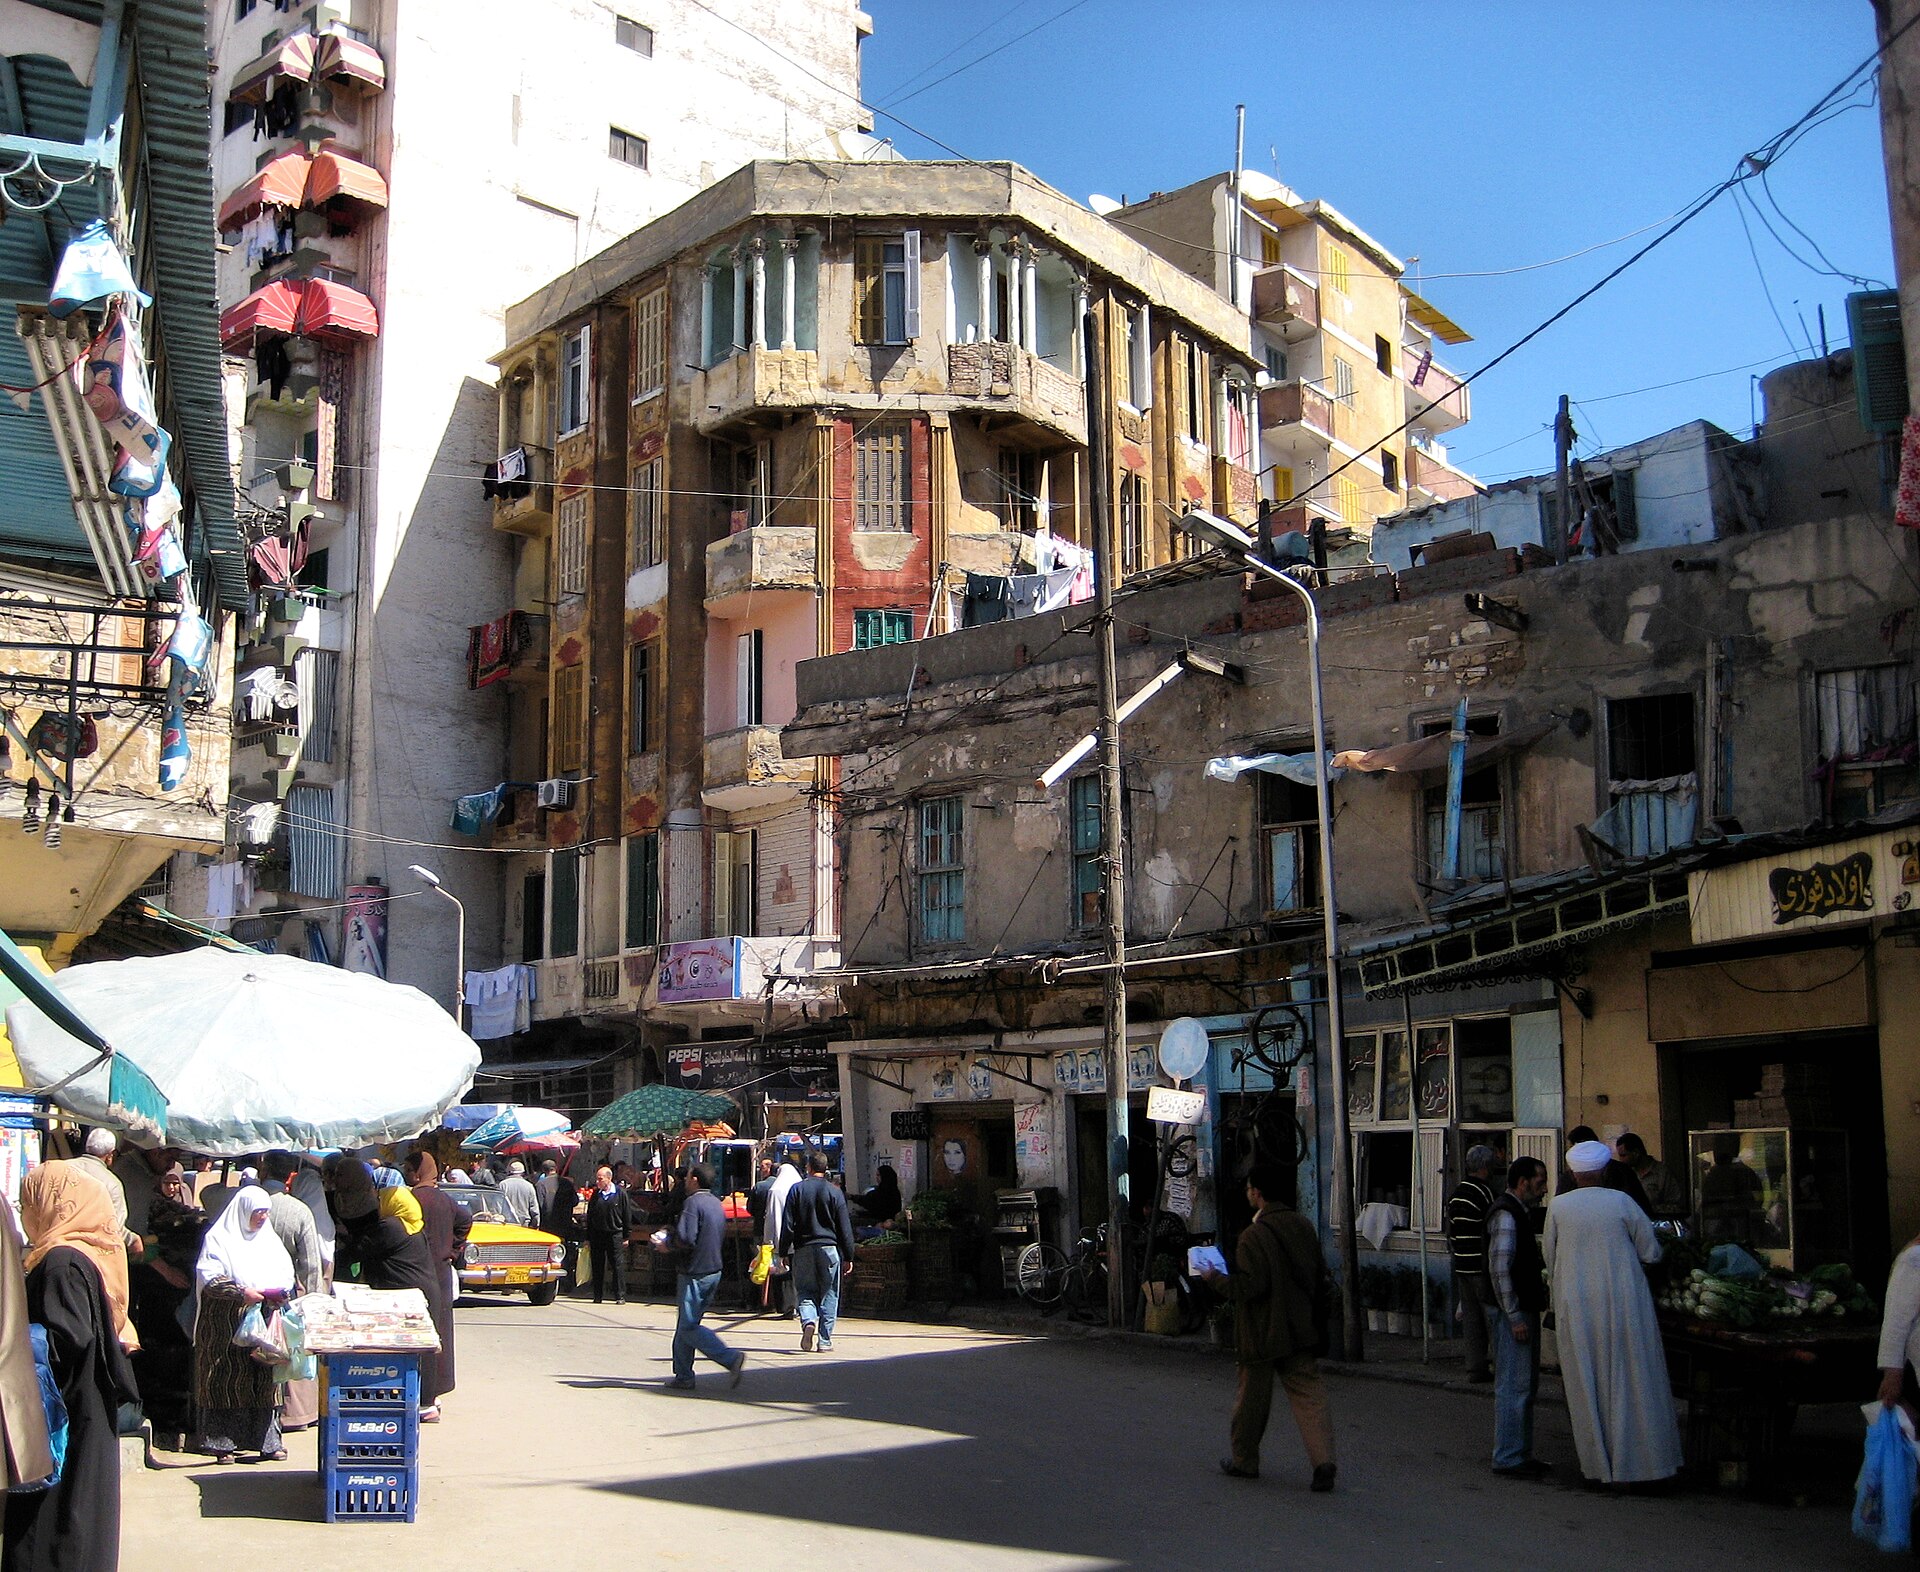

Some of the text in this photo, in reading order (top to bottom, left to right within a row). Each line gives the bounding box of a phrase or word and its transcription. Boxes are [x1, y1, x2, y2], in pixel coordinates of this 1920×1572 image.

[667, 1048, 703, 1063] PEPSI
[897, 1112, 925, 1125] SHOE
[347, 1422, 385, 1433] PEPSI
